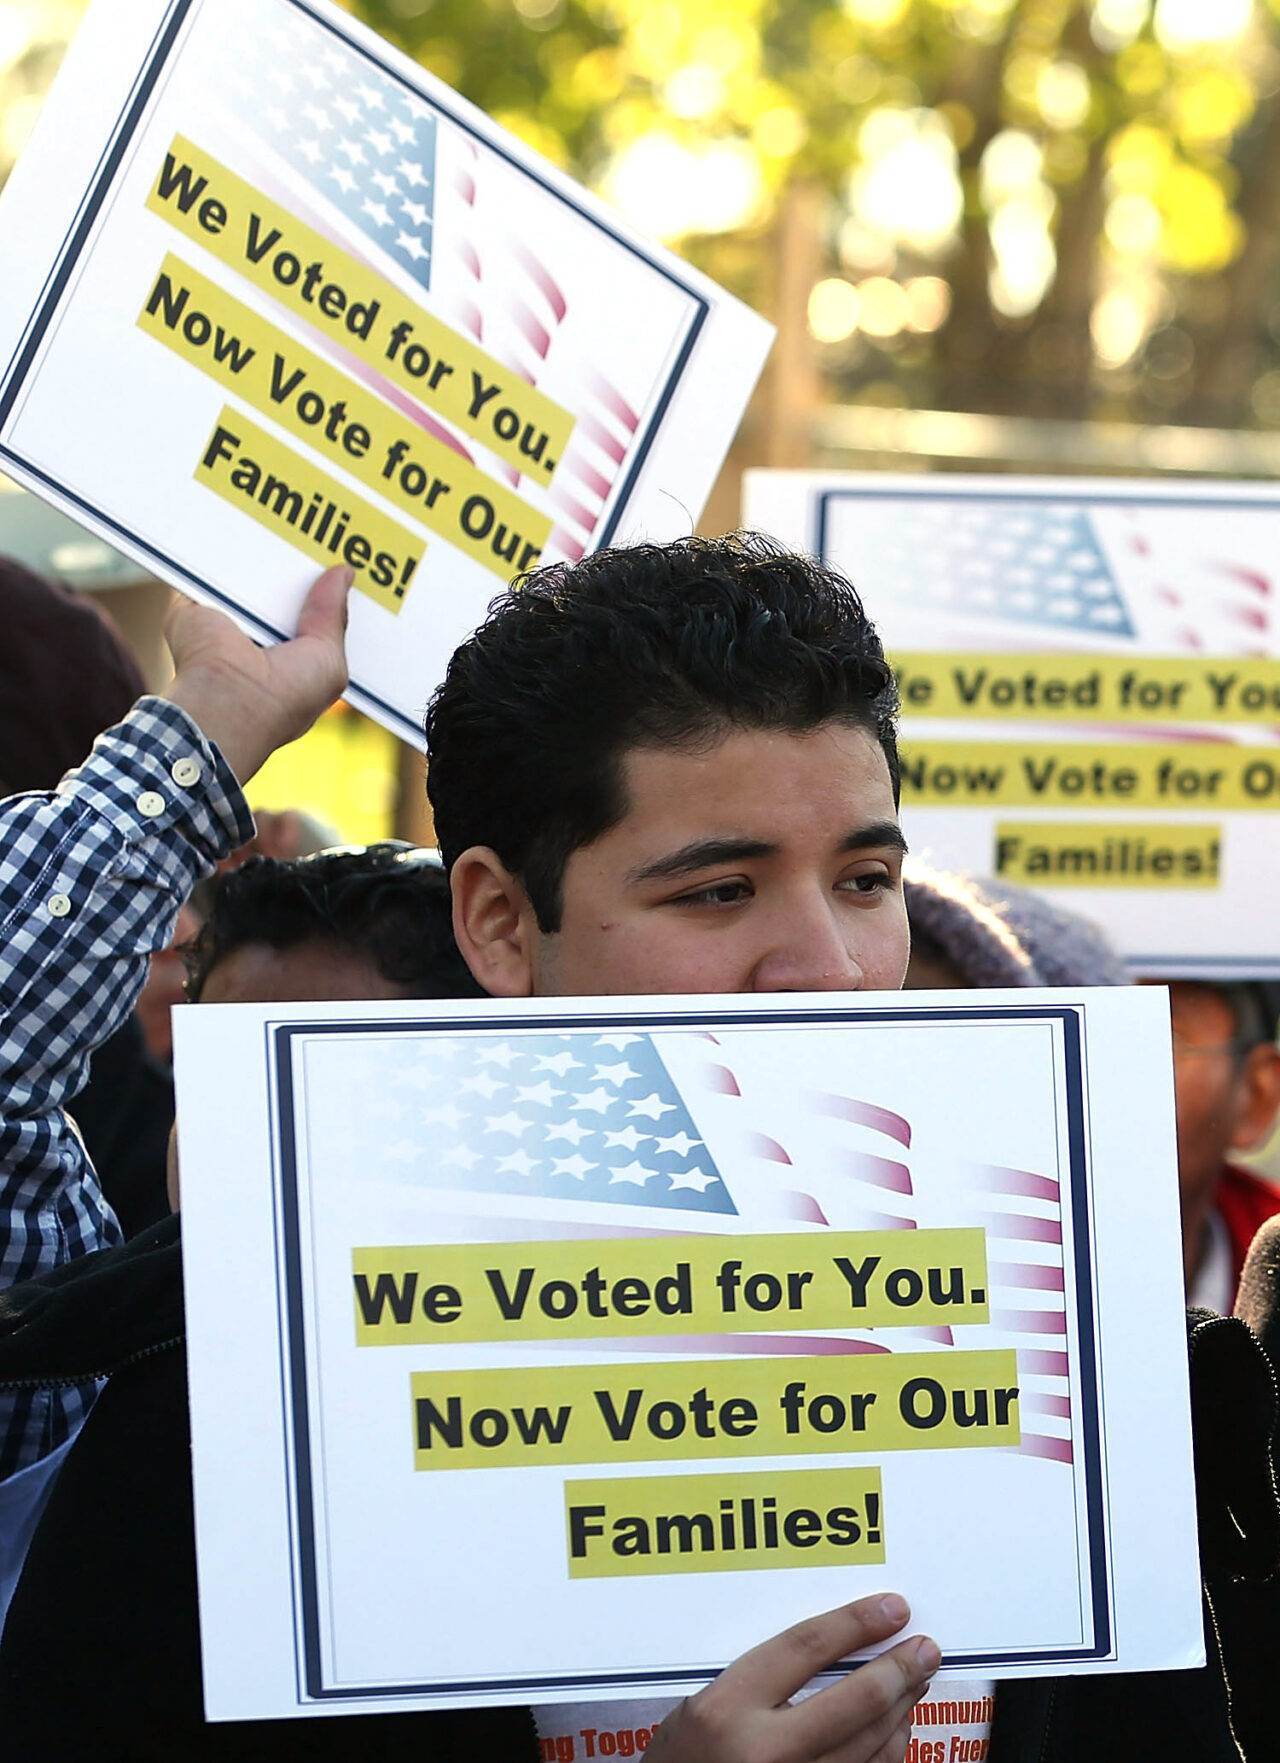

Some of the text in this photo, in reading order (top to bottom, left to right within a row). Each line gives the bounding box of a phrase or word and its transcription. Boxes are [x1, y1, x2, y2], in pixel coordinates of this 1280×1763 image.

[157, 152, 555, 472] We Voted for You.
[145, 273, 542, 572] Now Vote for Our
[202, 425, 417, 598] Families!
[897, 668, 934, 706] e
[953, 670, 1100, 707] Voted
[1120, 673, 1182, 708] for
[900, 755, 1004, 794] Now
[1022, 757, 1137, 796] Vote
[1157, 761, 1221, 796] for
[996, 838, 1220, 875] Families!
[353, 1256, 986, 1326] We Voted for You.
[415, 1377, 1020, 1450] Now Vote for Our
[569, 1492, 881, 1558] Families!
